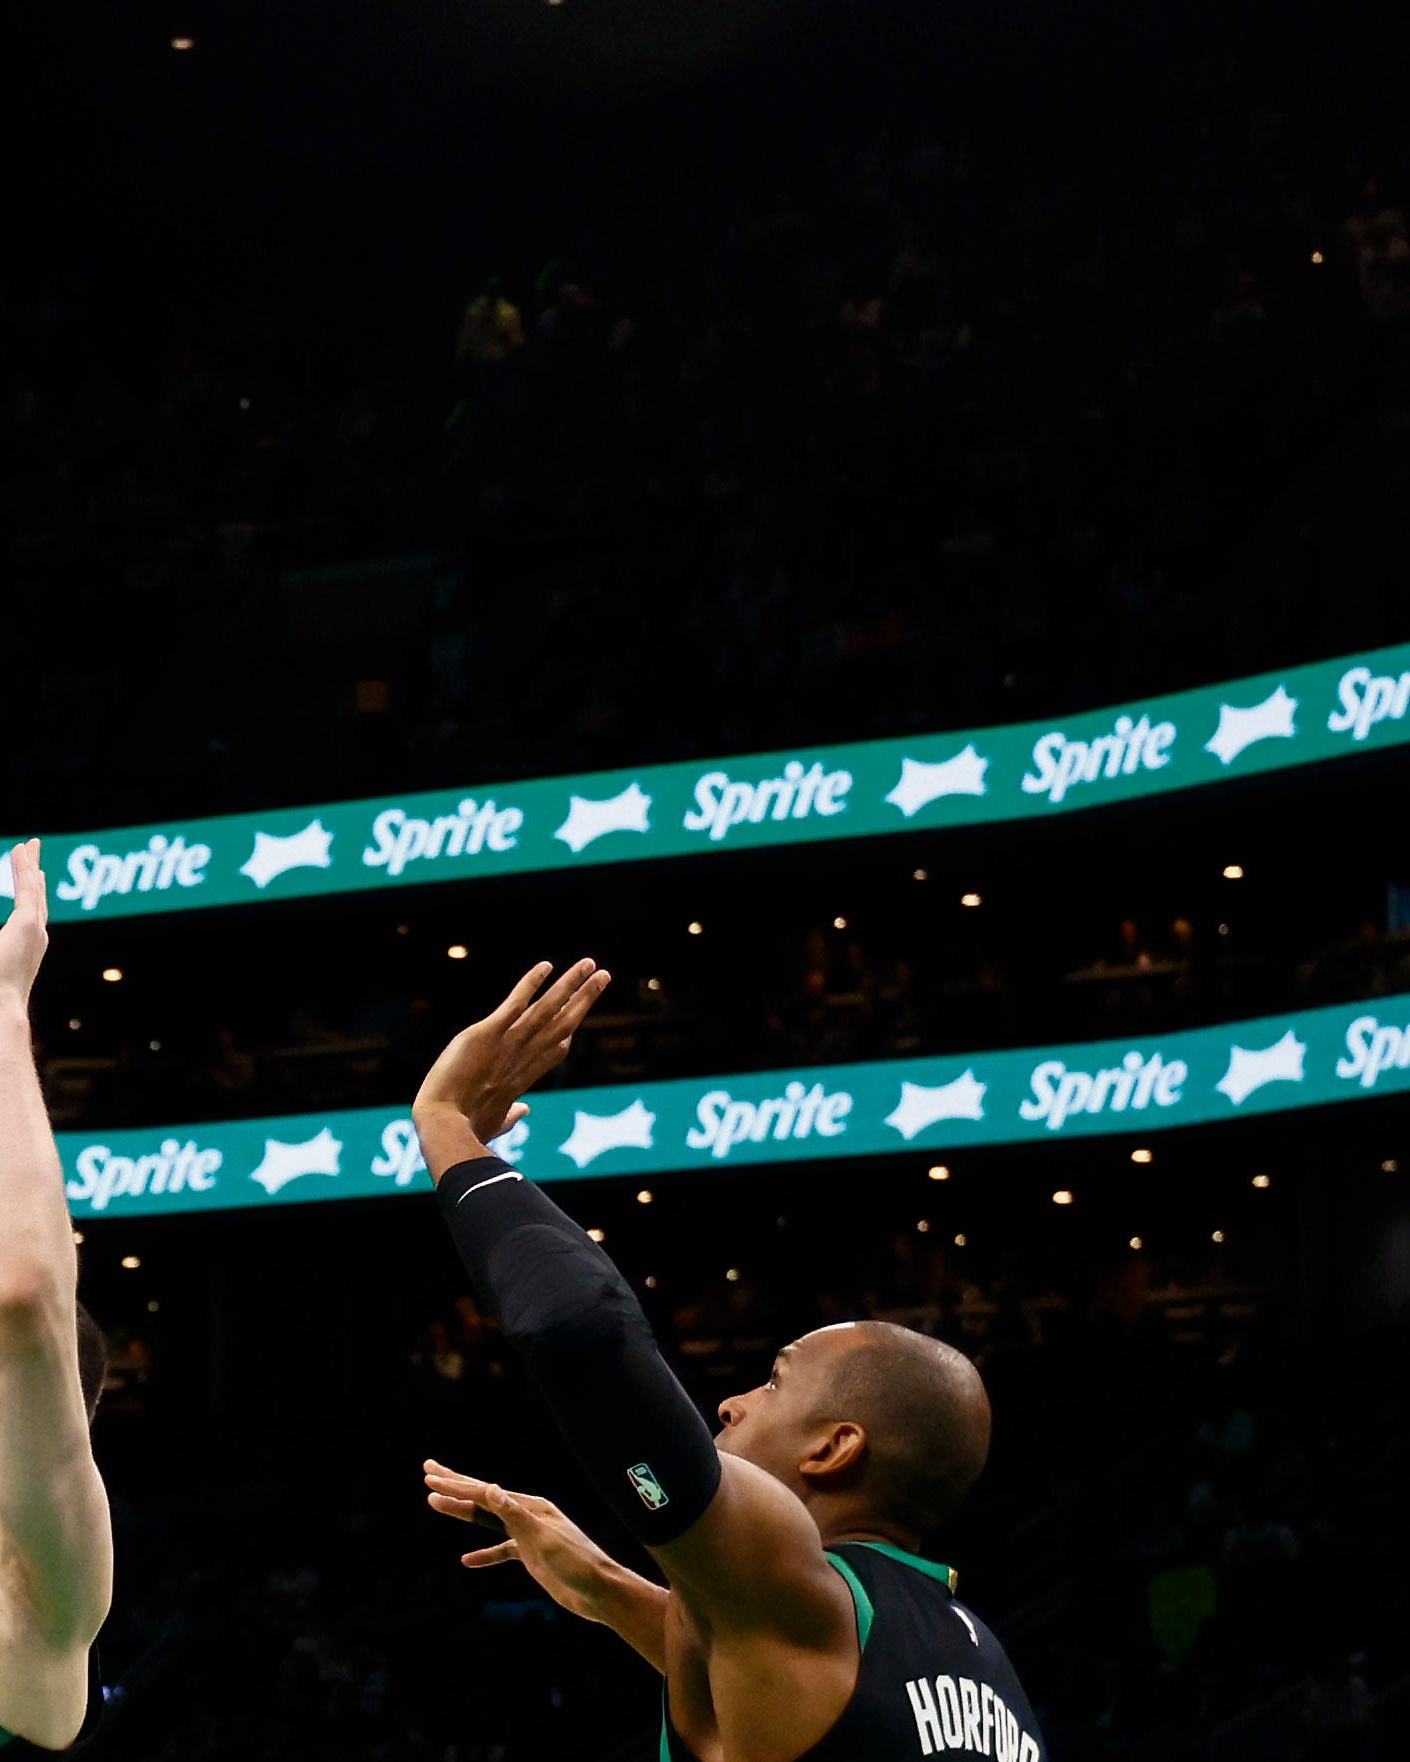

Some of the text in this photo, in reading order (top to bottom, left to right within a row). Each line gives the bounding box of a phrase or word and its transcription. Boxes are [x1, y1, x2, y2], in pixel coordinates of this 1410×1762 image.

[1021, 715, 1176, 802] Sprite
[362, 799, 524, 875] Sprite
[684, 761, 852, 840] Sprite
[57, 835, 211, 909] Sprite
[686, 1081, 852, 1158] Sprite
[1019, 1051, 1187, 1130] Sprite
[67, 1139, 222, 1209] Sprite
